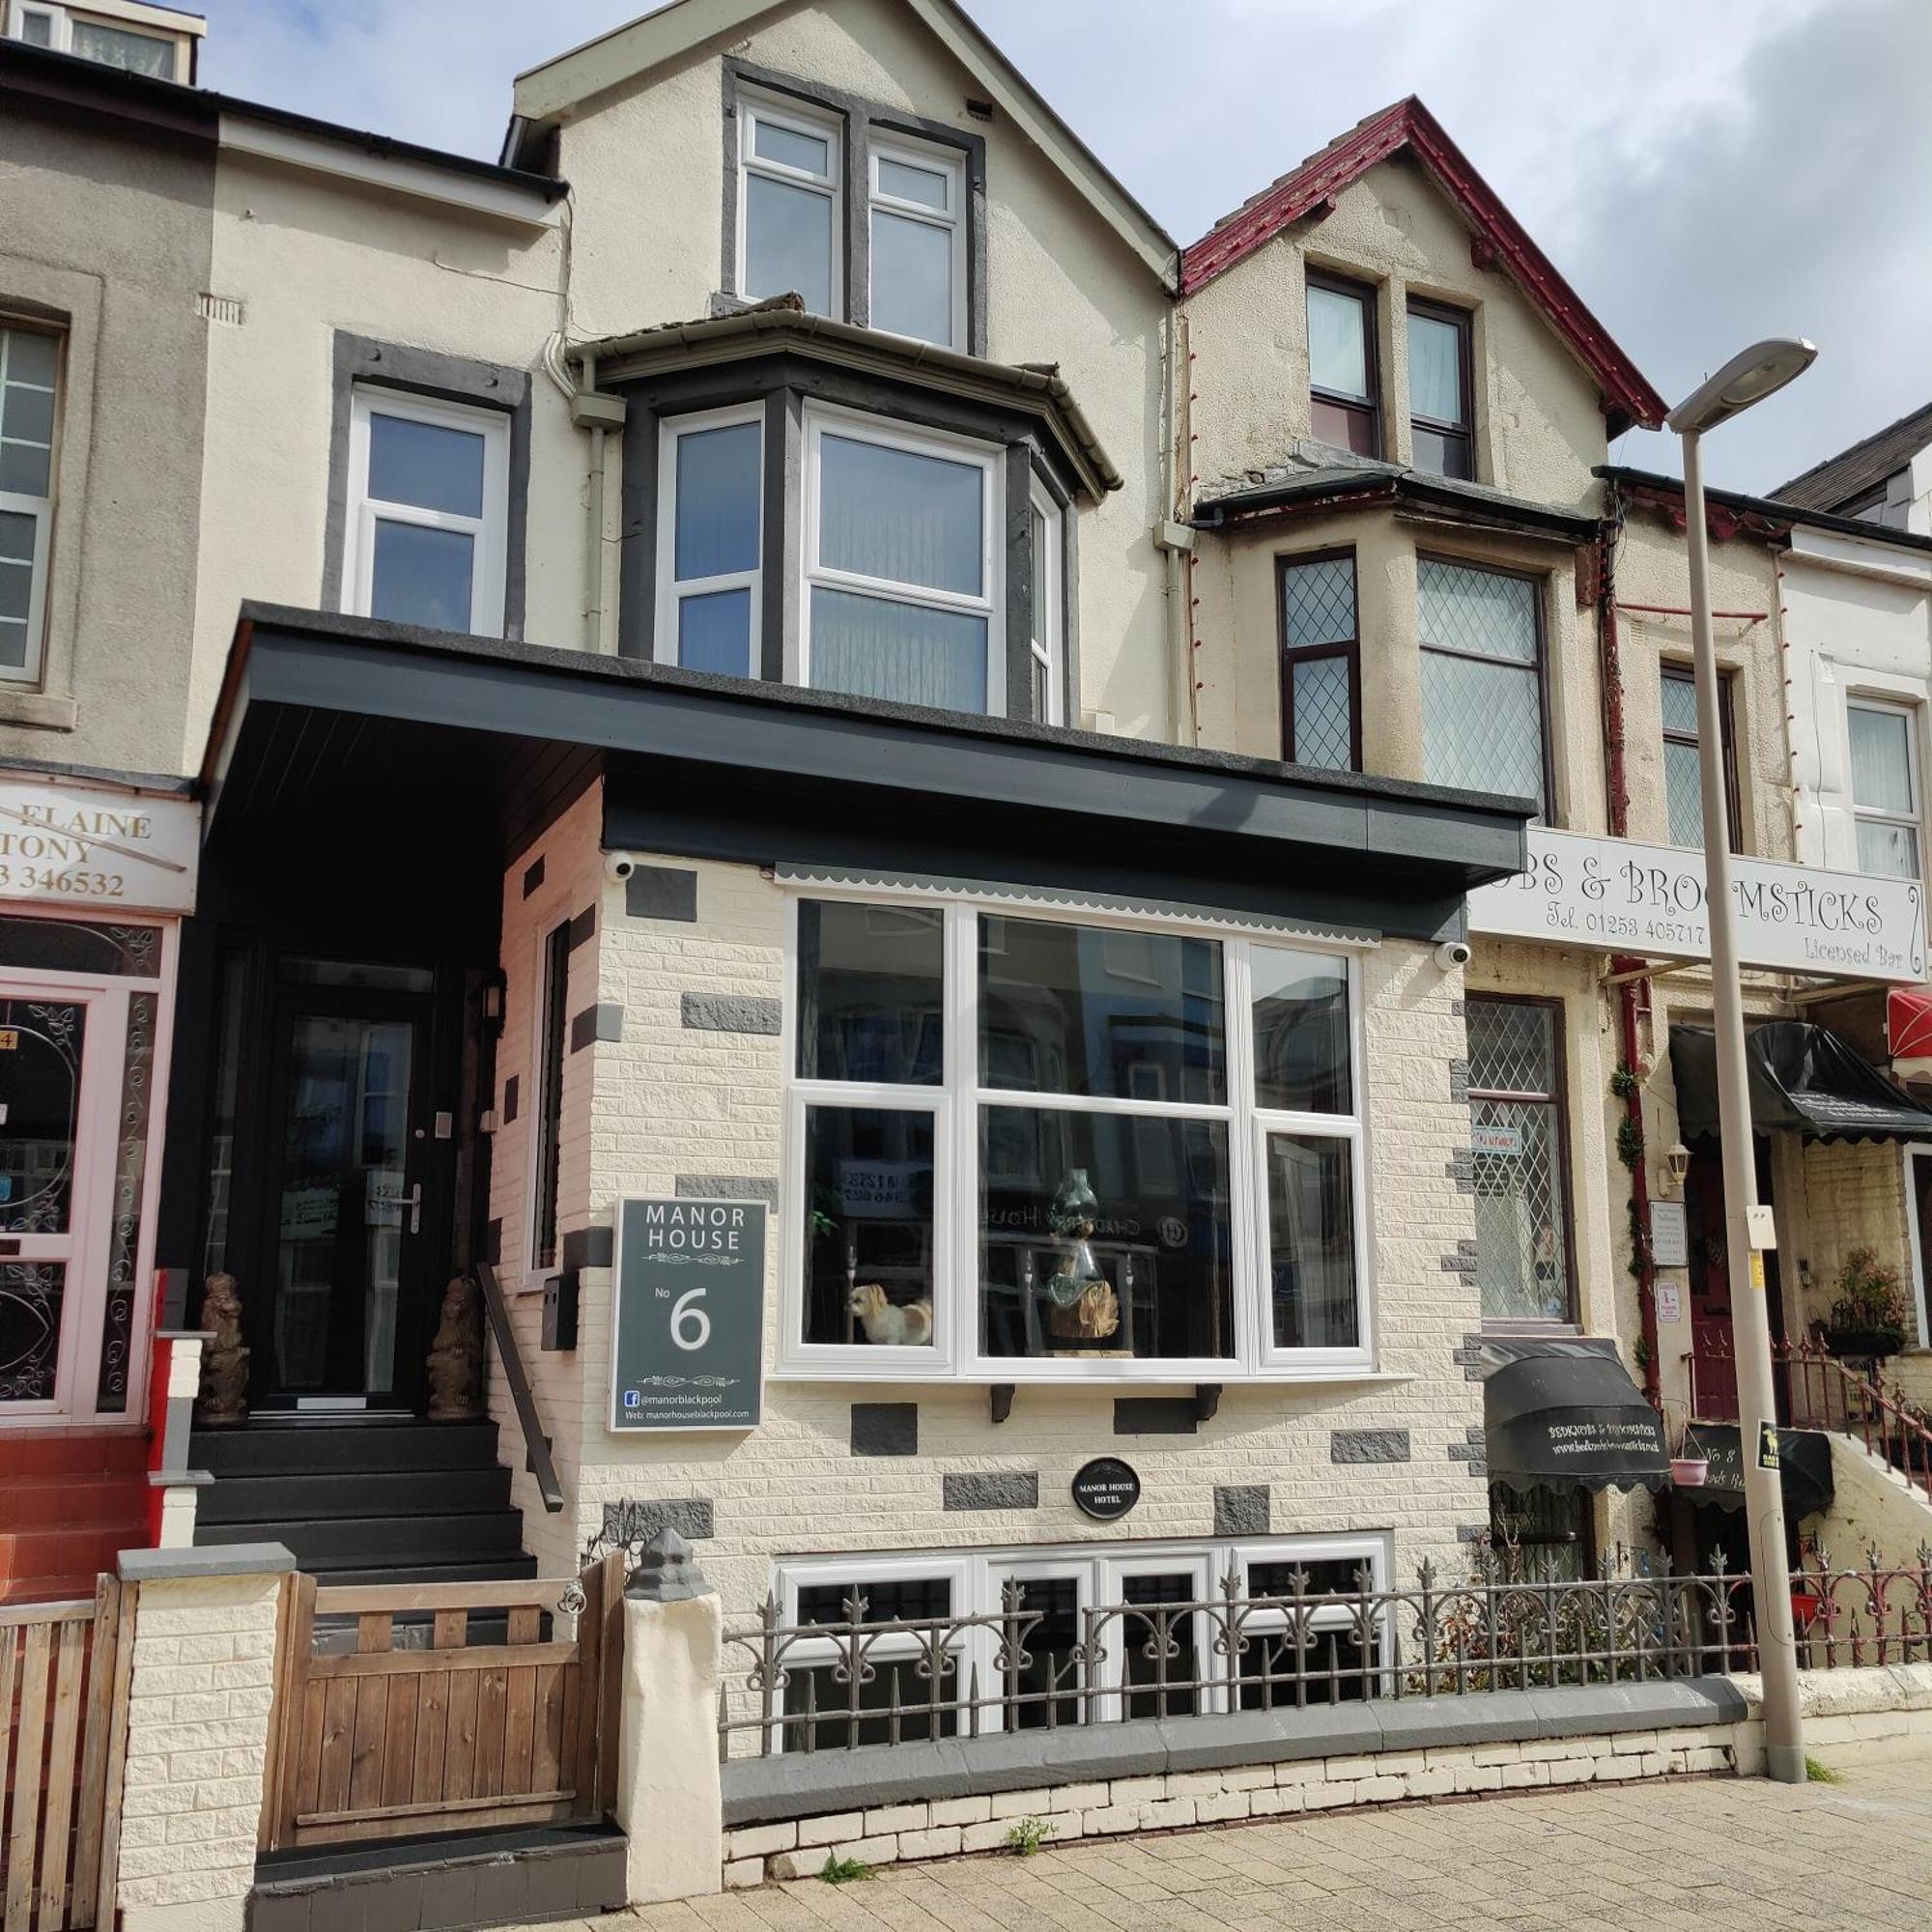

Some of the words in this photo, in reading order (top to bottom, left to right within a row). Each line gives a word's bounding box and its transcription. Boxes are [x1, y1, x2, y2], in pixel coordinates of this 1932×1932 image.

[20, 803, 152, 838] ELAINE
[0, 833, 94, 864] TONY
[19, 866, 125, 897] 346532
[1581, 856, 1611, 900] &
[1620, 860, 1883, 935] BROMSTICKS
[1546, 900, 1578, 929] Tel.
[1586, 912, 1638, 937] 01253
[1645, 920, 1705, 945] 405717
[1804, 937, 1870, 965] Licensed
[1875, 944, 1904, 970] Bar
[645, 1205, 745, 1228] MANOR
[648, 1229, 740, 1250] HOUSE
[655, 1288, 670, 1298] No
[670, 1287, 711, 1350] 6
[640, 1393, 723, 1406] @manorblackpool
[1726, 1449, 1736, 1463] 8
[1080, 1483, 1107, 1492] MANOR
[1108, 1483, 1135, 1492] HOUSE
[1094, 1495, 1122, 1504] HOTEL
